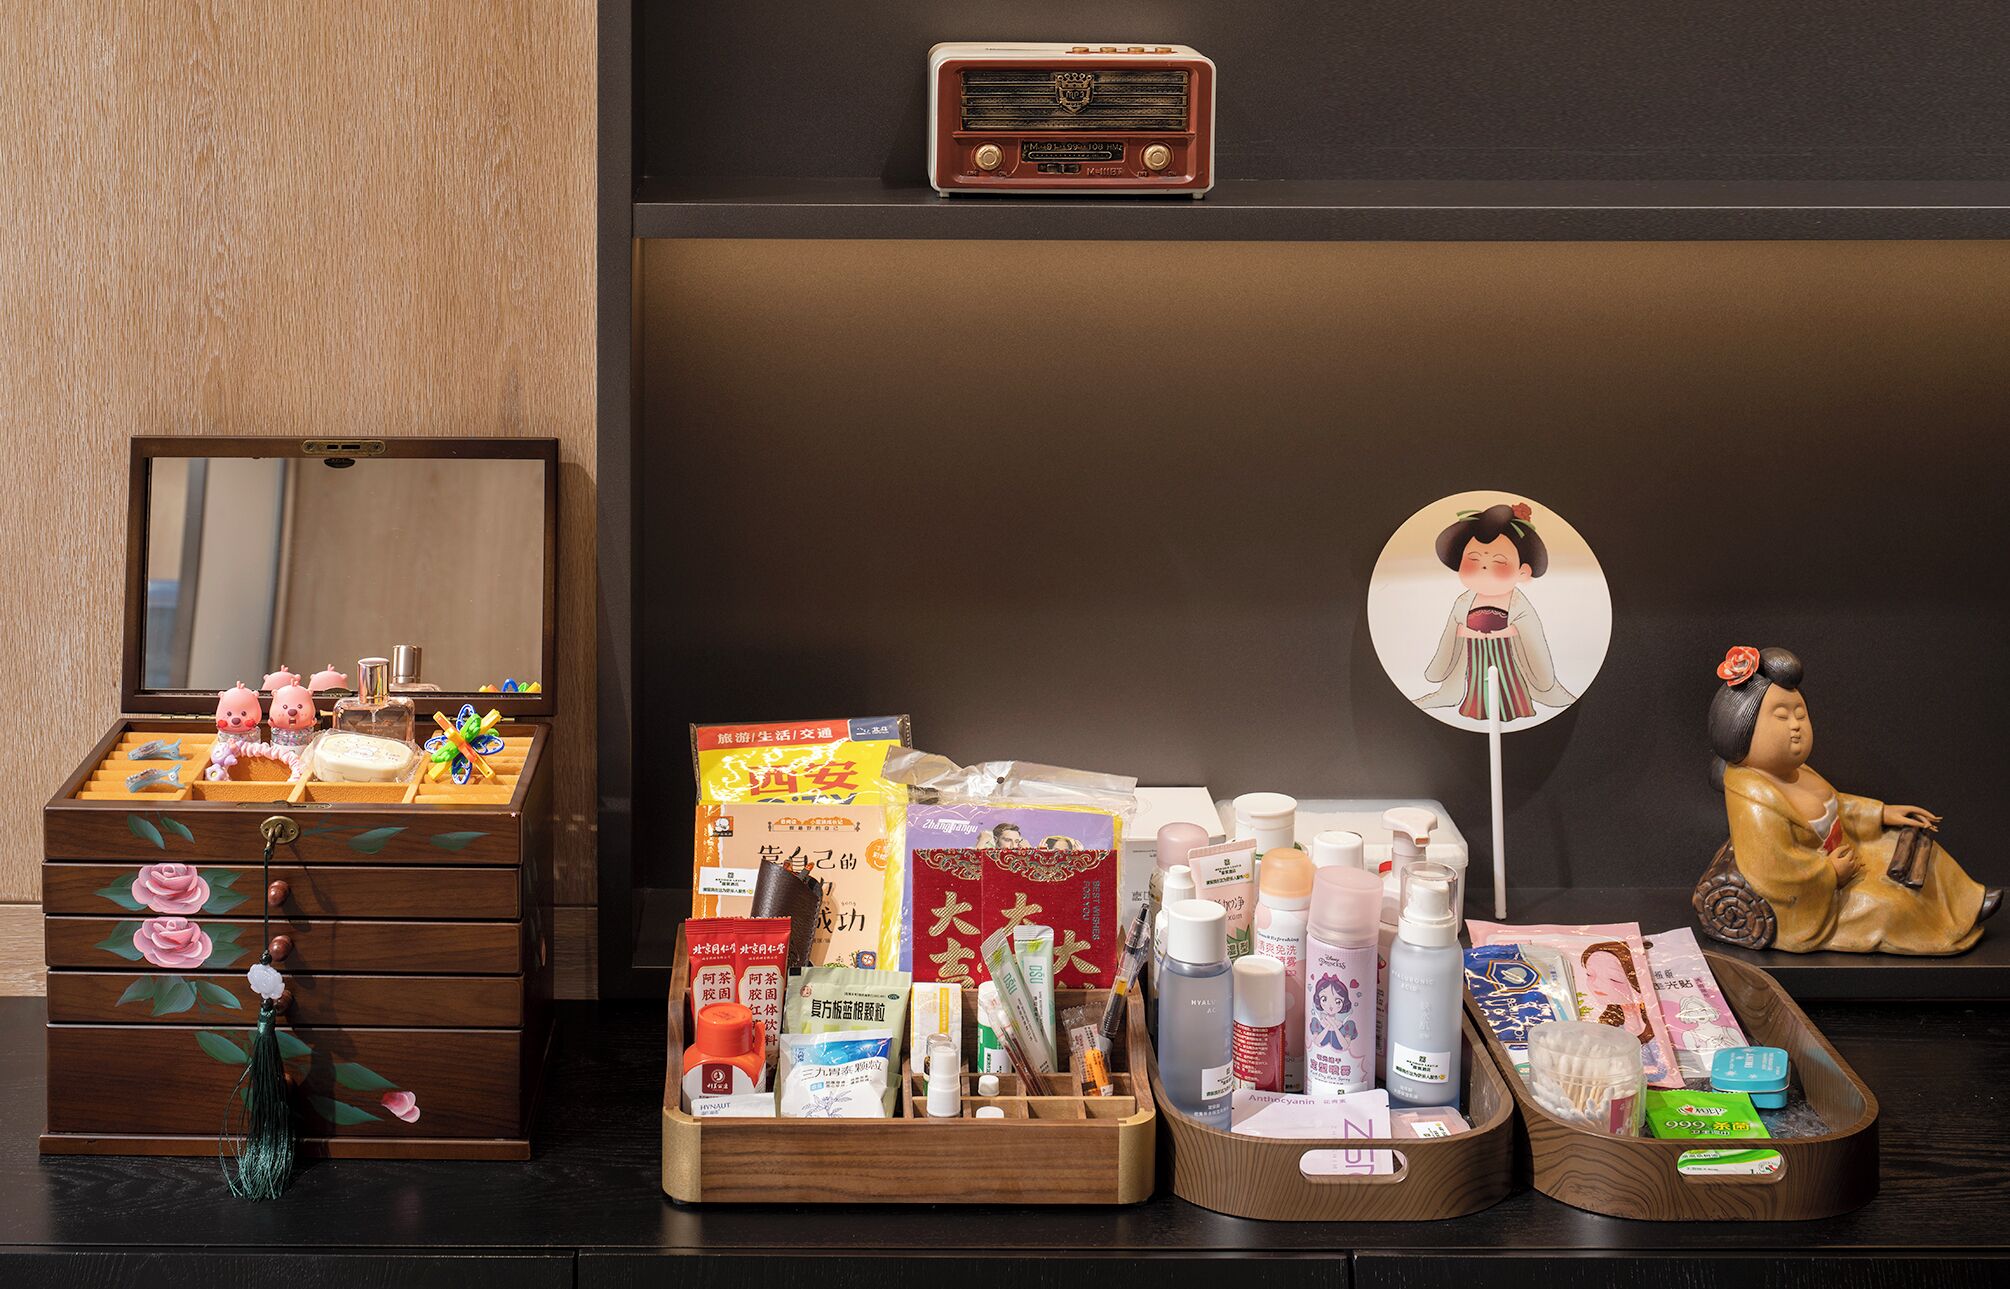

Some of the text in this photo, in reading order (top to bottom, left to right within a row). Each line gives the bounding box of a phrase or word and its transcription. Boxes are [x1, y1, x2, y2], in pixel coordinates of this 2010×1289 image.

[739, 942, 786, 955] 北京同仁堂
[810, 999, 886, 1022] 复方板蓝根颗粒
[1248, 1094, 1316, 1106] Anthocyanin
